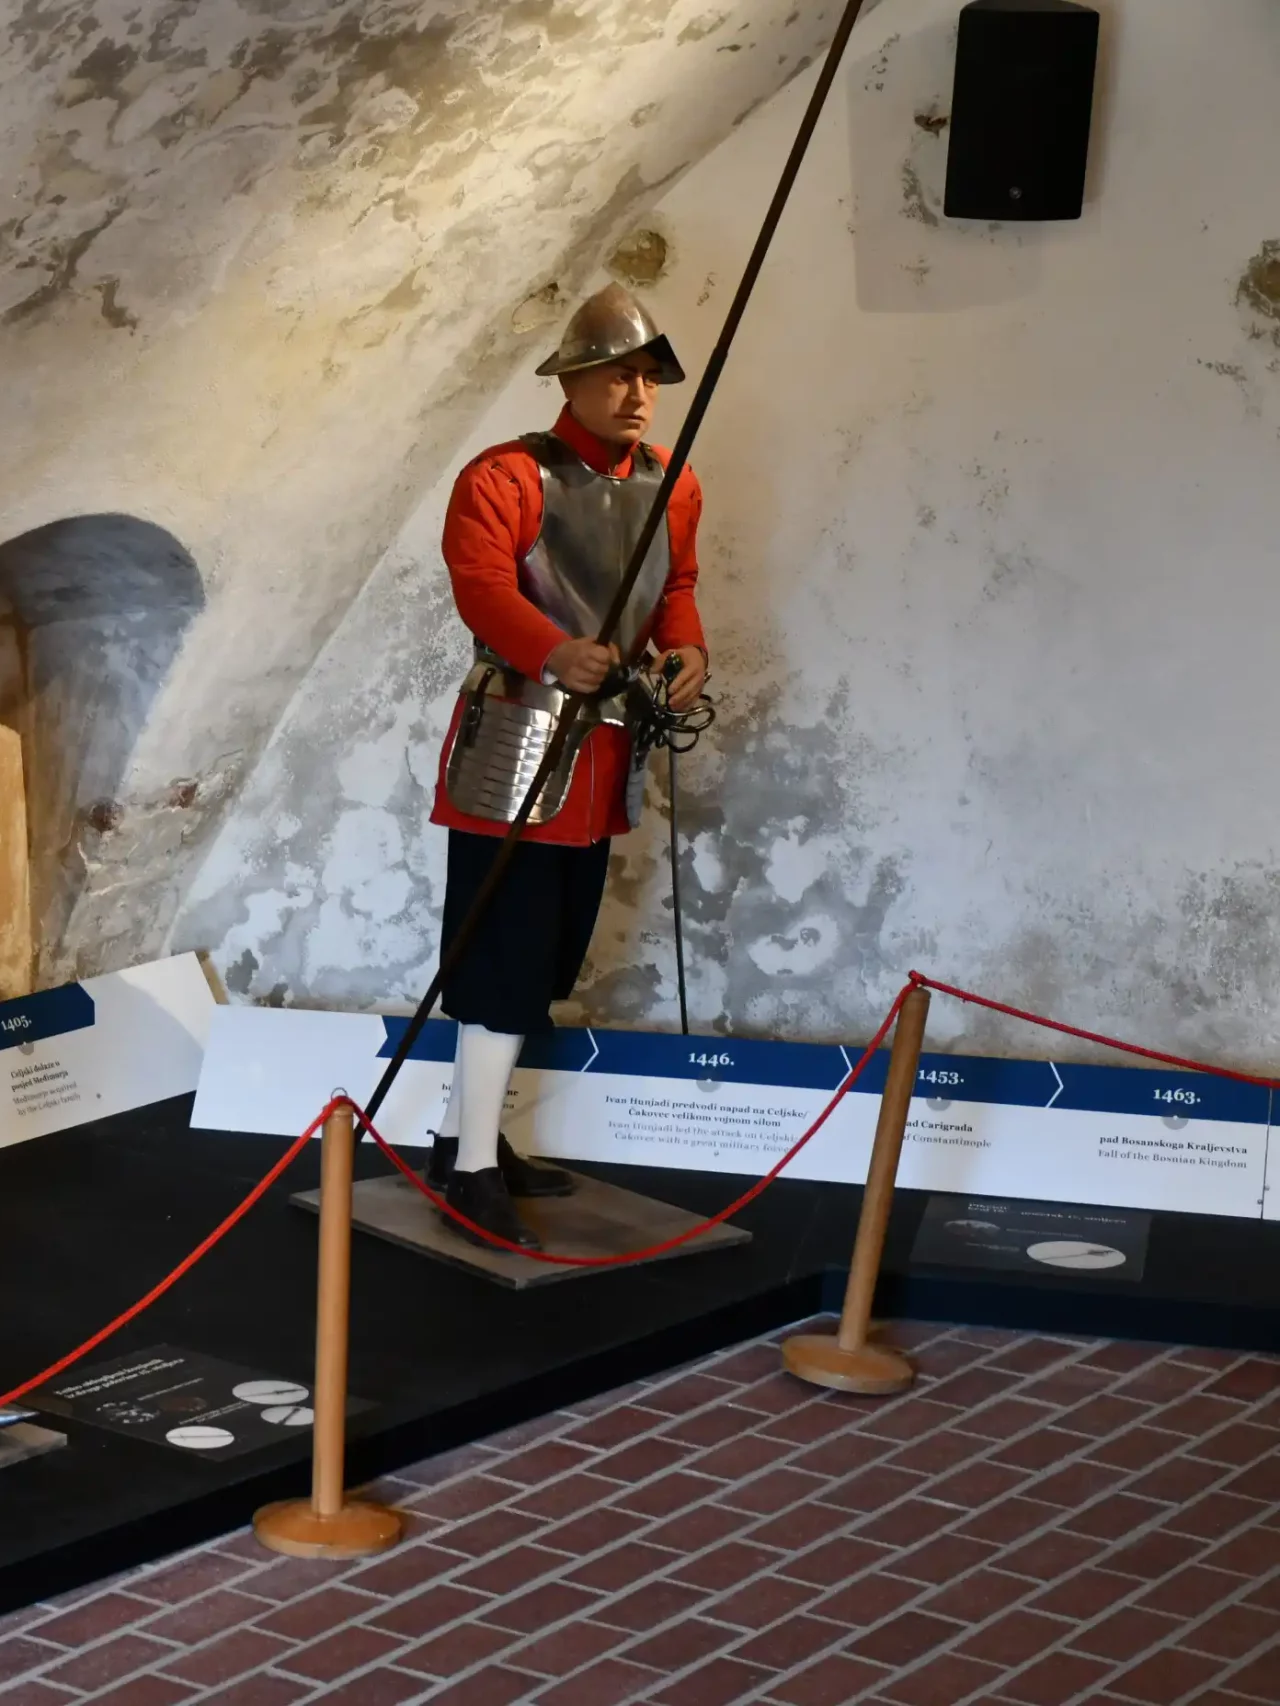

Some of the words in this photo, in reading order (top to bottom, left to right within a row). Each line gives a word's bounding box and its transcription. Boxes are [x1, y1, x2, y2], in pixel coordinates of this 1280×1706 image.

[1, 1015, 32, 1031] 1405.
[688, 1052, 735, 1067] 1446.
[918, 1069, 965, 1085] 1453.
[1153, 1088, 1202, 1105] 1463.
[605, 1095, 627, 1104] Ivan
[630, 1097, 671, 1108] Hunjadi
[672, 1101, 718, 1110] predvodi
[720, 1105, 751, 1115] napad
[628, 1106, 670, 1119] Čakovec
[672, 1111, 712, 1122] velikom
[714, 1114, 751, 1125] vojnom
[753, 1118, 781, 1127] silom
[906, 1119, 919, 1128] ad
[921, 1120, 973, 1133] Carigrada
[912, 1135, 992, 1148] Constantinople
[1099, 1135, 1119, 1146] pad
[1121, 1137, 1185, 1151] Bosanskoga
[1187, 1141, 1248, 1156] Kraljevstva
[1098, 1149, 1118, 1160] Fall
[1120, 1151, 1132, 1161] of
[1132, 1152, 1150, 1162] the
[1152, 1154, 1197, 1166] Bosnian
[1199, 1157, 1248, 1170] Kingdom
